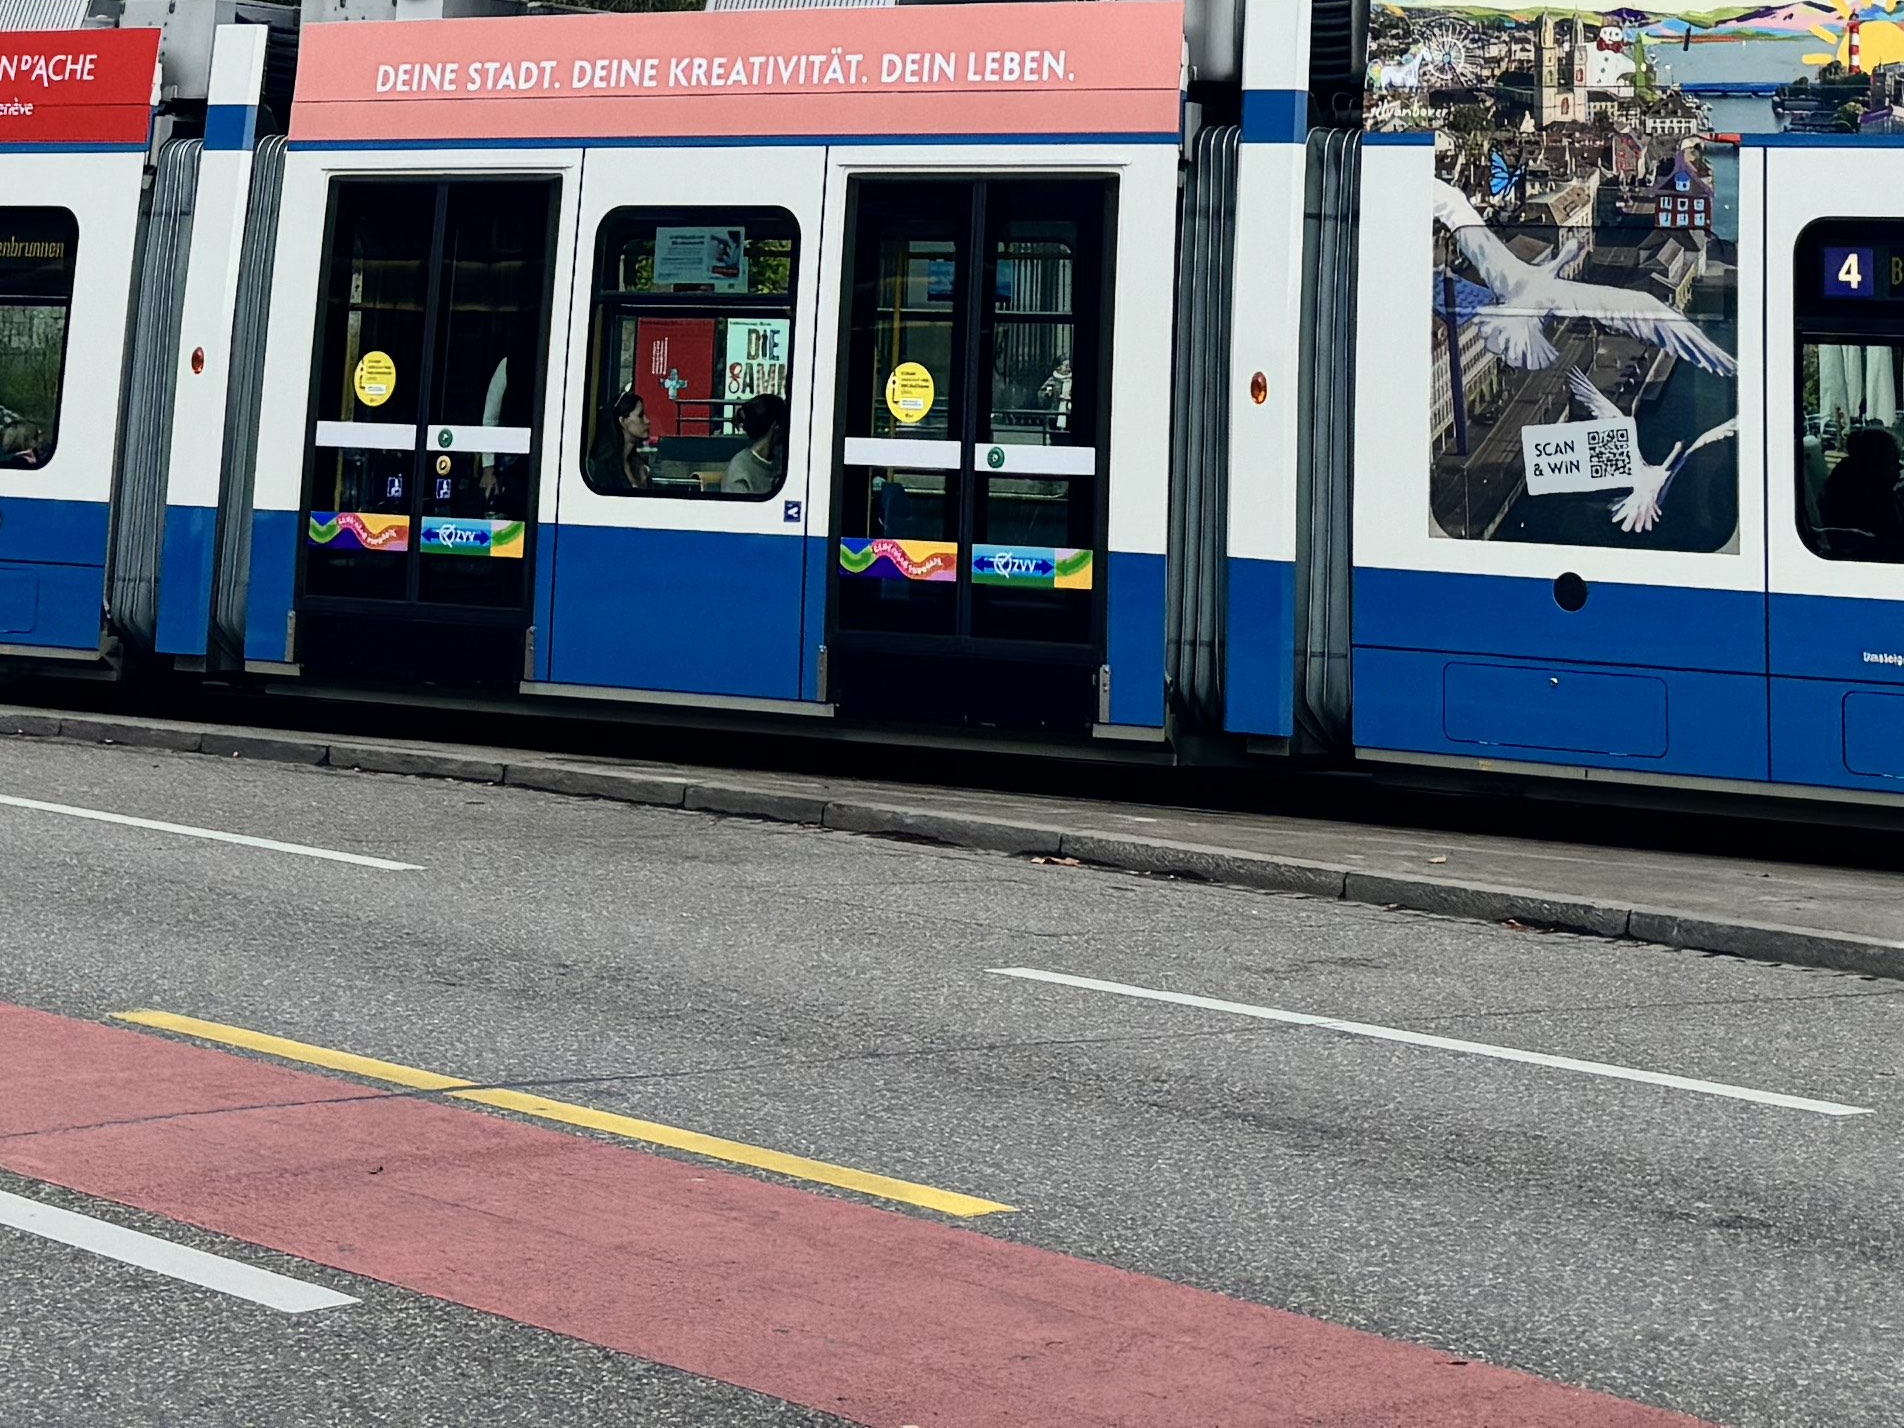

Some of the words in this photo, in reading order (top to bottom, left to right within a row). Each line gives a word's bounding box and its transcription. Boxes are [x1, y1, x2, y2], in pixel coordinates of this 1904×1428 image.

[376, 63, 458, 93] DEINE
[466, 60, 561, 92] STADT.
[572, 58, 659, 89] DEINE
[668, 47, 868, 87] KREATIVITÄT.
[881, 52, 956, 84] DEIN
[967, 50, 1076, 82] LEBEN.
[1838, 253, 1862, 289] 4
[747, 328, 780, 361] DIE
[1534, 440, 1575, 457] SCAN
[1533, 463, 1544, 477] &
[1547, 460, 1580, 475] WIN
[1012, 559, 1037, 573] ZVV
